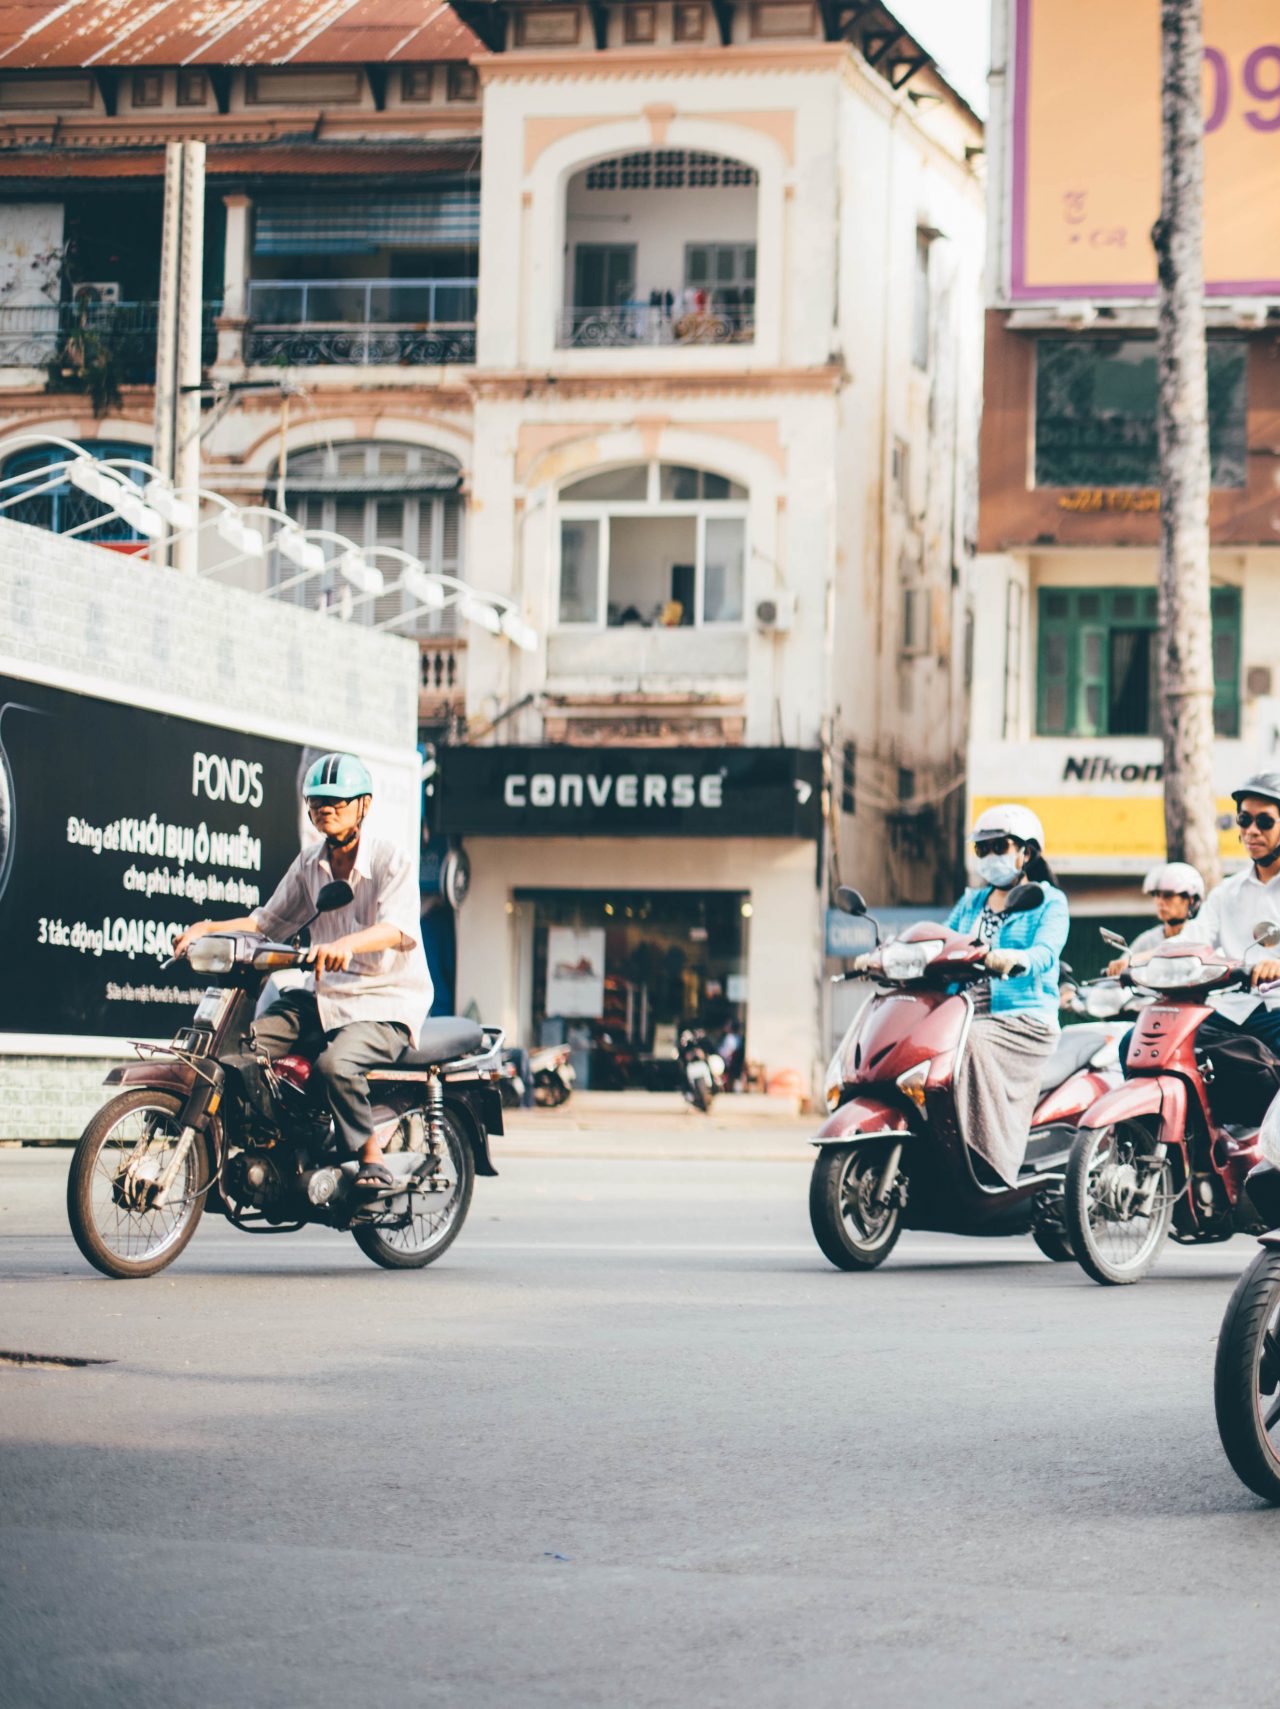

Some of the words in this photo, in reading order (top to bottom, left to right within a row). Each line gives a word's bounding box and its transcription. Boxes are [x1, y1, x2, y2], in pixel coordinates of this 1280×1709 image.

[192, 751, 264, 808] POND'S
[504, 773, 723, 808] CONVERSE
[1061, 756, 1164, 783] Nikon
[165, 823, 195, 867] BỤI
[195, 821, 211, 864] Ô
[37, 917, 48, 944] 3
[49, 918, 70, 947] tác
[103, 916, 145, 960] LOẠI
[144, 920, 189, 962] SẠC
